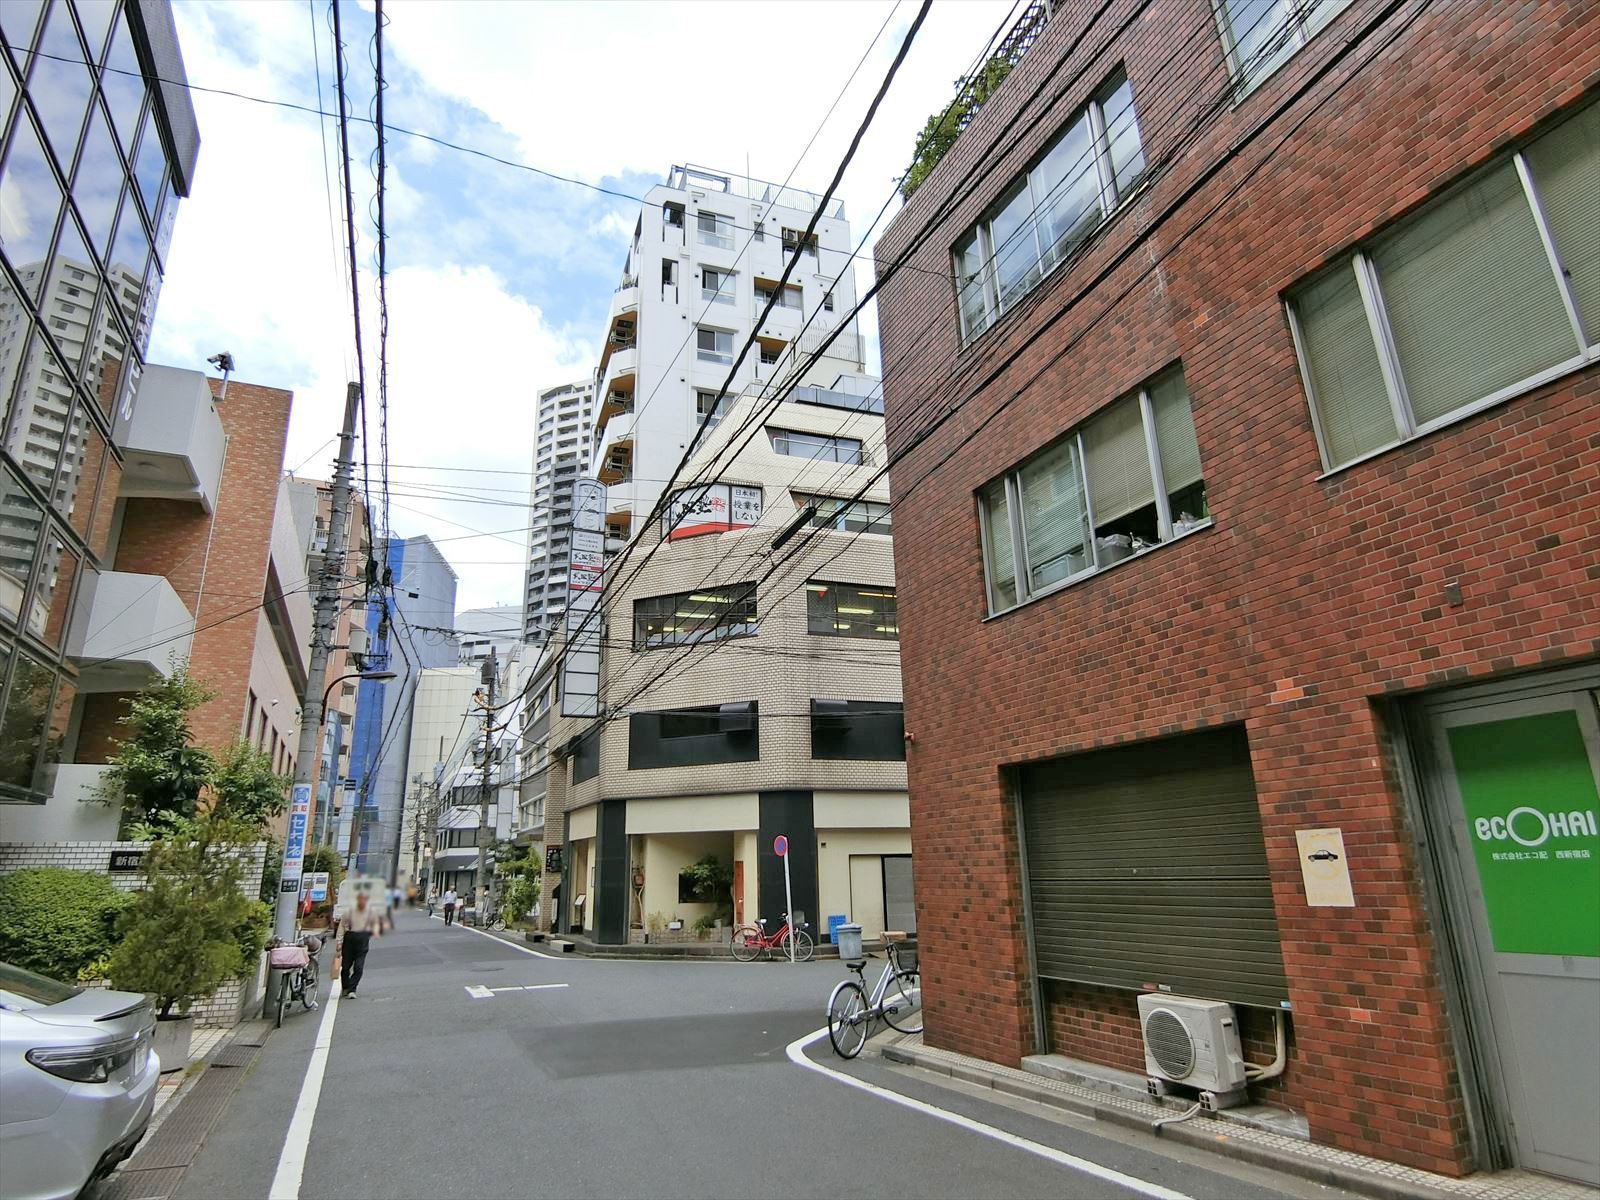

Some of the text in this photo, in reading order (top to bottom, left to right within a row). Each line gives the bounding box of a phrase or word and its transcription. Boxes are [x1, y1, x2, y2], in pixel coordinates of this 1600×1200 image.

[734, 500, 760, 511] 授業を
[735, 512, 759, 521] しない
[288, 815, 304, 857] セキネ
[1492, 850, 1548, 861] 株式会社エコ配
